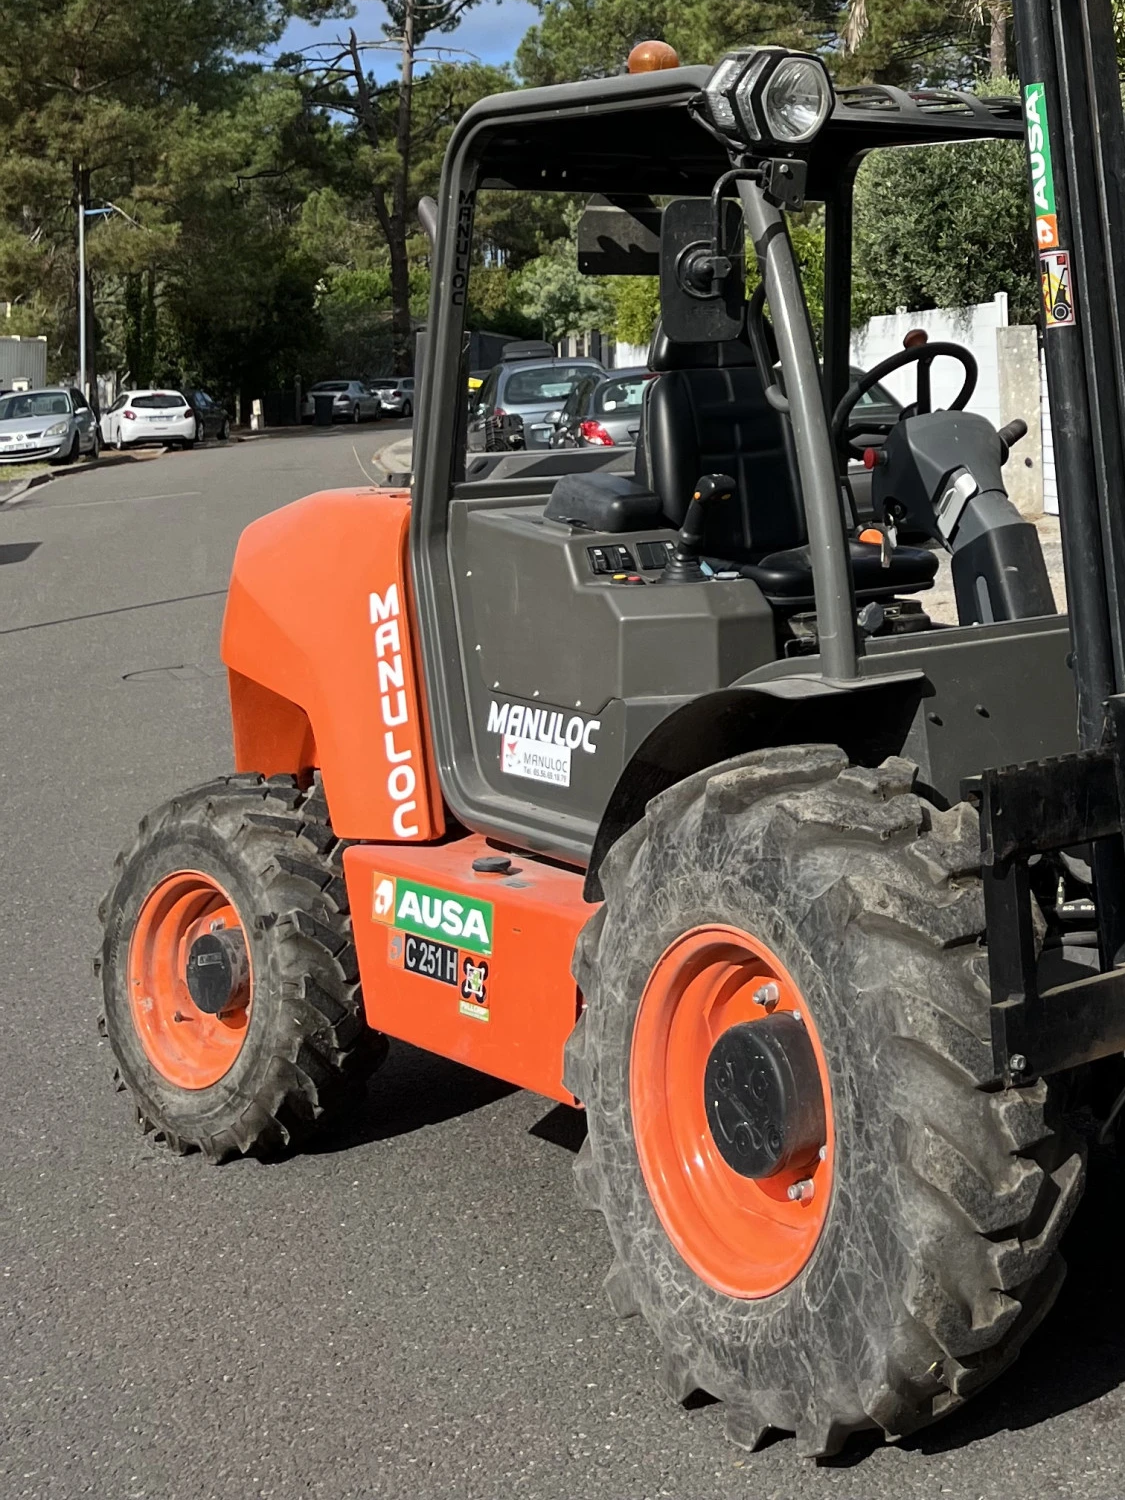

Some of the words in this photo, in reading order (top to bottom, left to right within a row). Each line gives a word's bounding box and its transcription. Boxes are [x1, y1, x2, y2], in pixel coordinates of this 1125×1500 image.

[1026, 90, 1049, 211] AUSA
[368, 582, 419, 839] MANULOC
[486, 700, 601, 754] MANULOC
[523, 751, 568, 774] MANULOC
[396, 890, 490, 944] AUSA
[405, 938, 417, 968] C
[418, 942, 443, 978] 251
[446, 949, 458, 982] H
